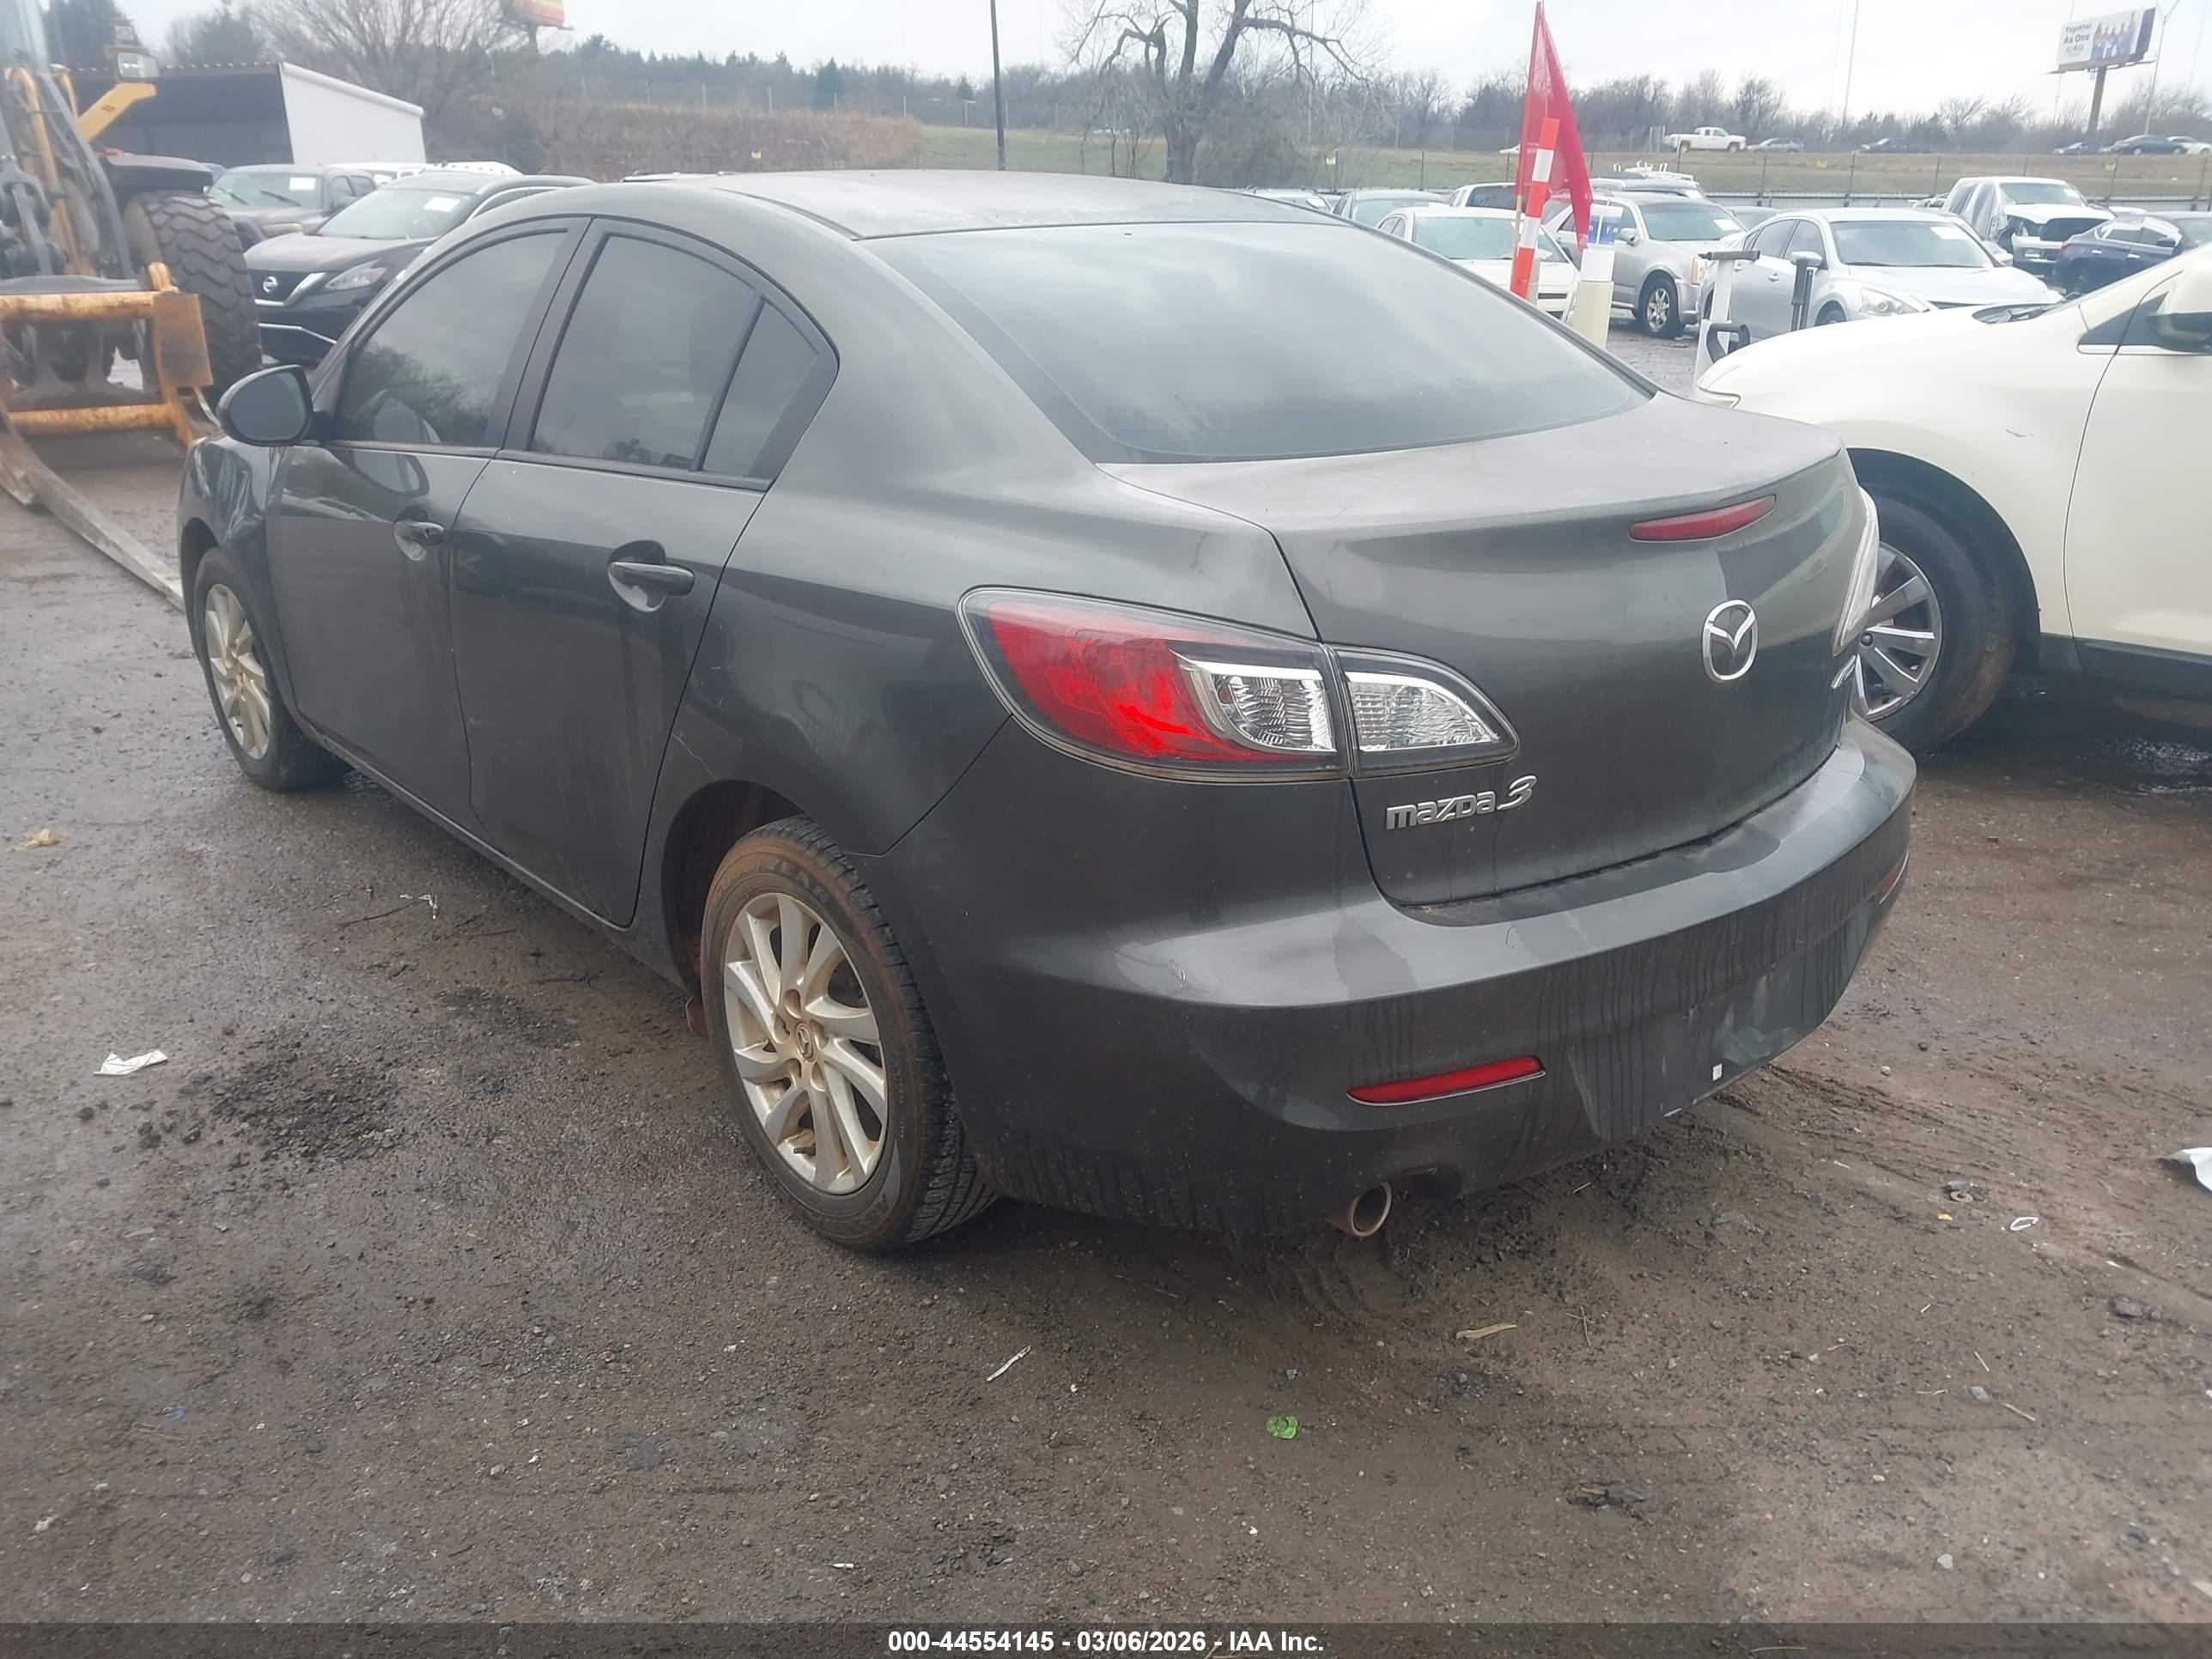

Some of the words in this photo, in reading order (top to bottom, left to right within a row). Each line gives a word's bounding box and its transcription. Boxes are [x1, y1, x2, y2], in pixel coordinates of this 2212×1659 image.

[2065, 24, 2093, 33] Together
[2075, 33, 2090, 43] One
[1497, 775, 1537, 811] 3
